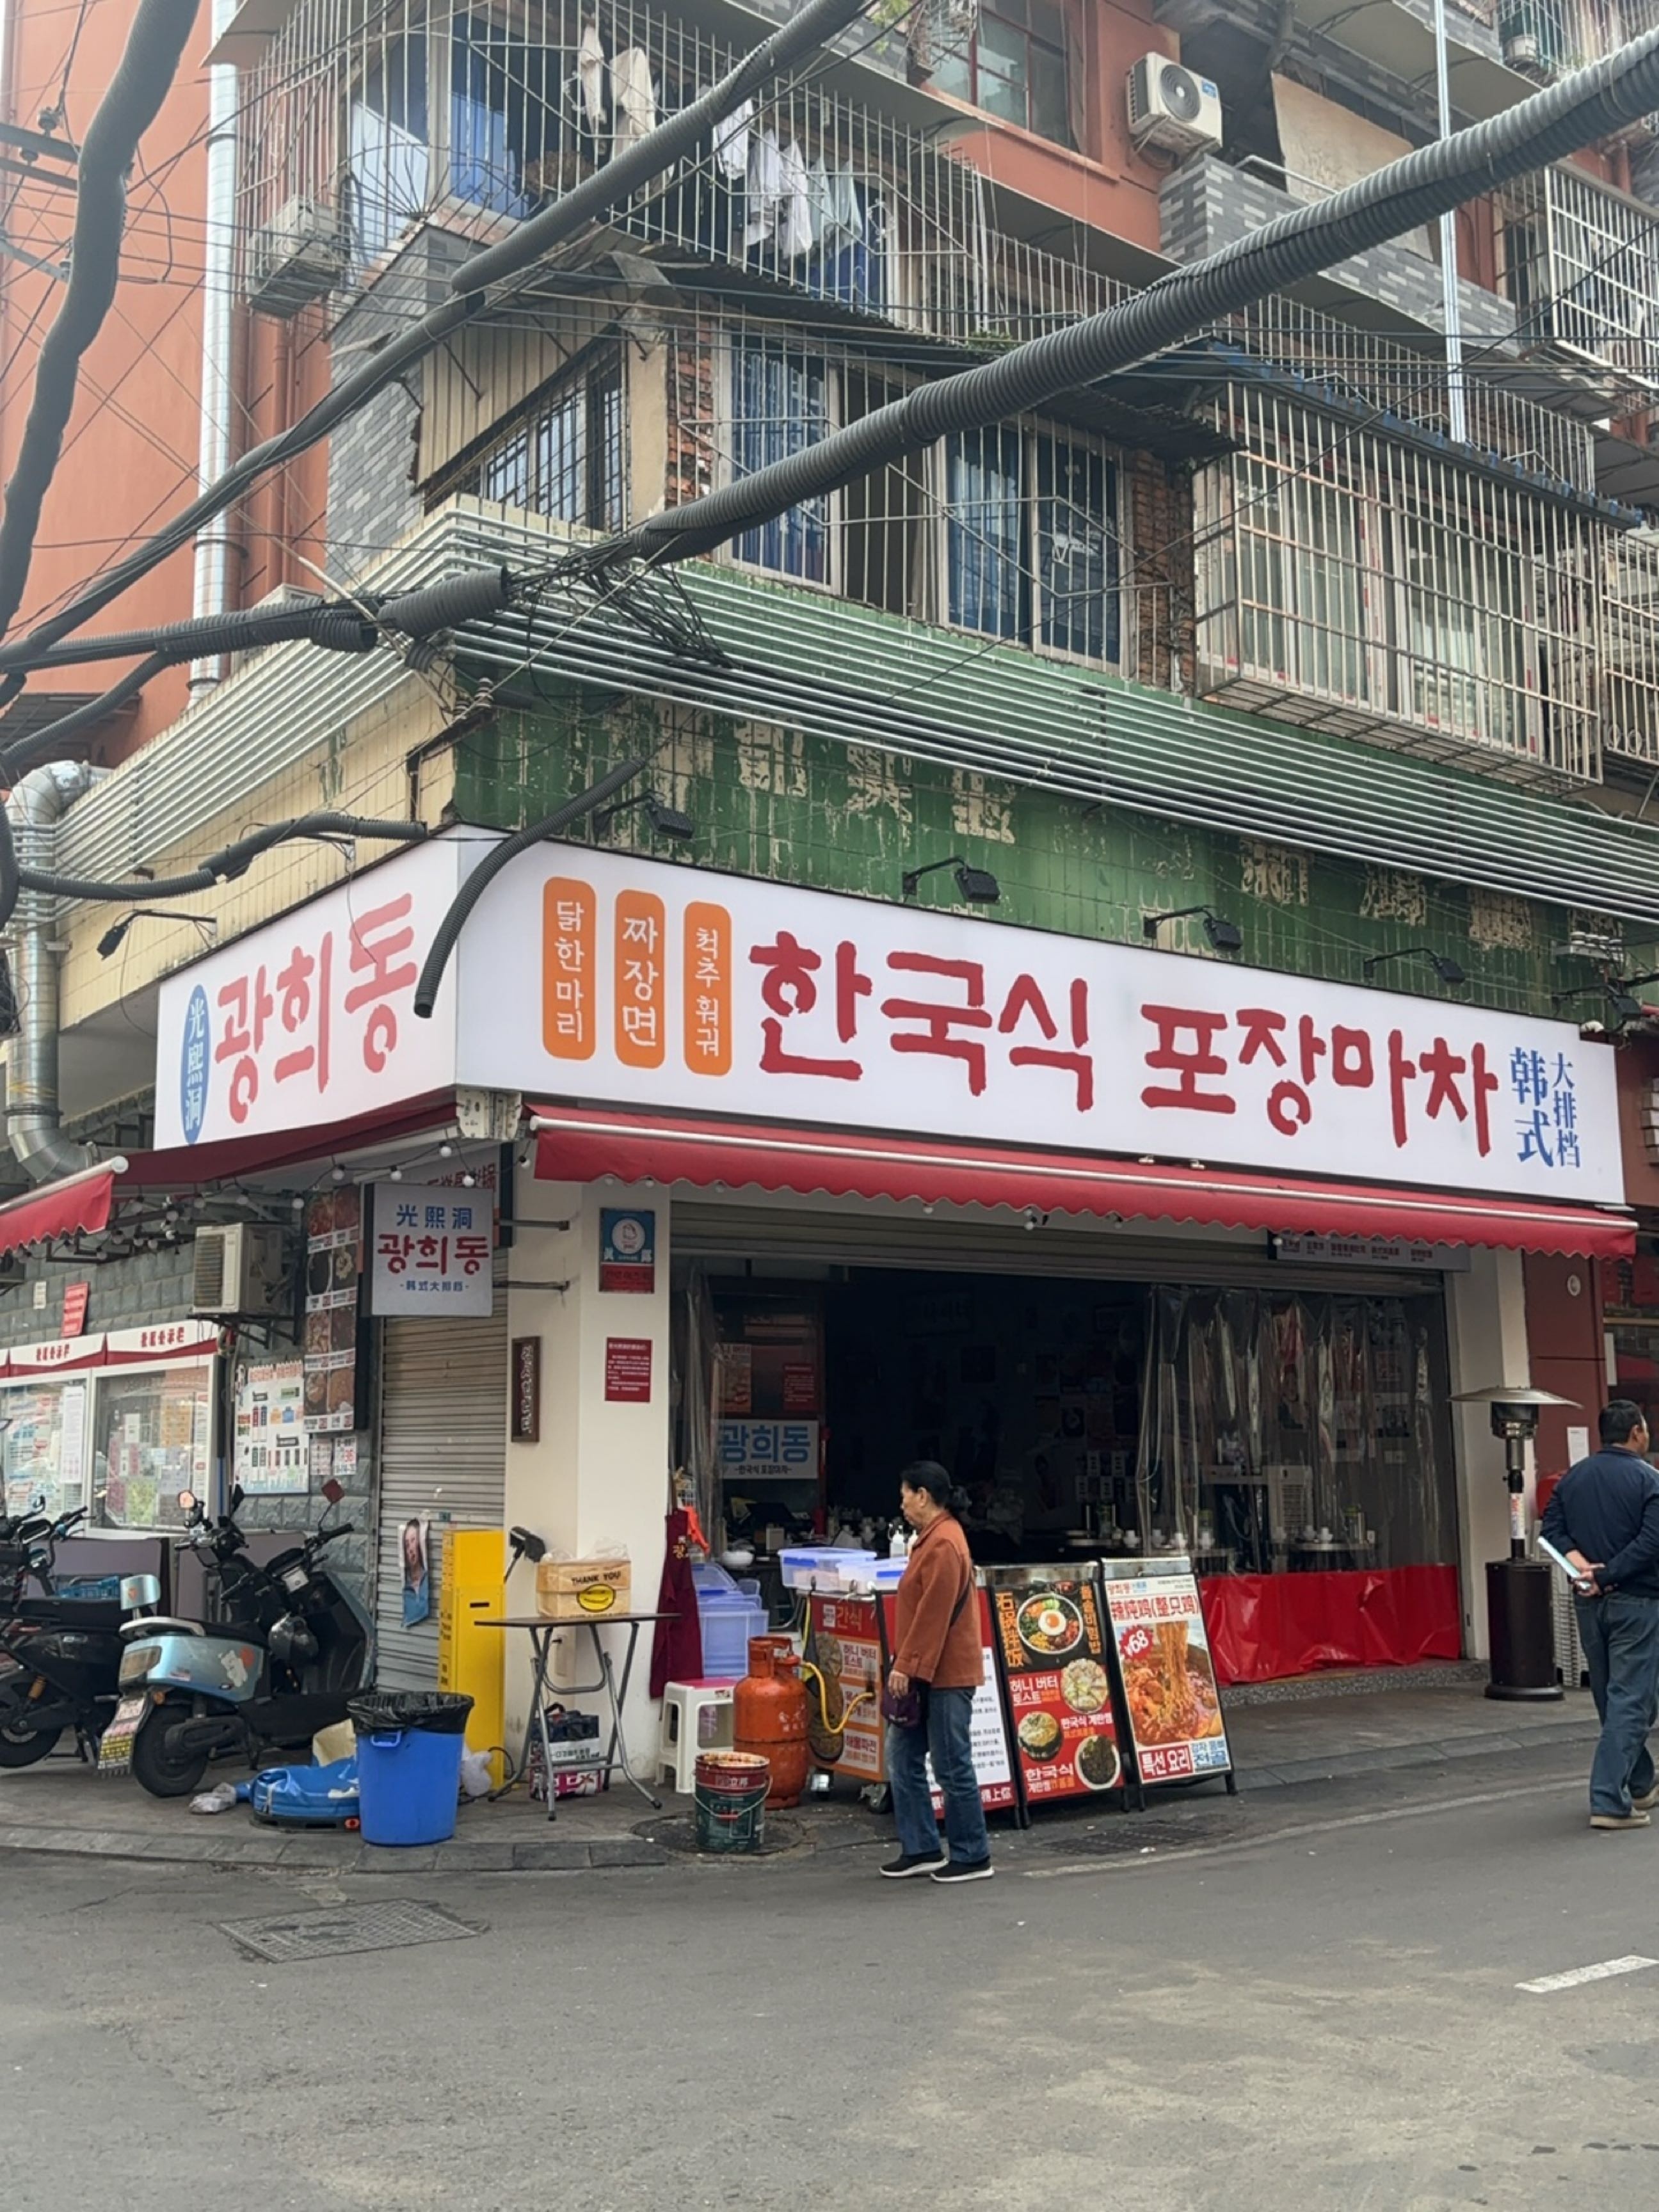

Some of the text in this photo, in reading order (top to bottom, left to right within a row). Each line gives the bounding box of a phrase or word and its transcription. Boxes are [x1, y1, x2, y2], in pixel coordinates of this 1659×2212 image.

[215, 894, 417, 1123] 광희동
[554, 901, 585, 1043] 닭한마리
[622, 917, 659, 1047] 짜장면
[695, 927, 721, 1057] 척추훠궈
[749, 931, 1498, 1158] 한국식 포장마차
[1509, 1046, 1554, 1168] 韩式
[1550, 1052, 1580, 1168] 大排档
[378, 1234, 489, 1276] 광희동
[396, 1204, 472, 1230] 光熙洞
[719, 1425, 810, 1463] 광희동
[571, 1571, 621, 1585] THANK YOU
[1025, 1763, 1073, 1781] 한국식
[1167, 1747, 1190, 1772] 요리
